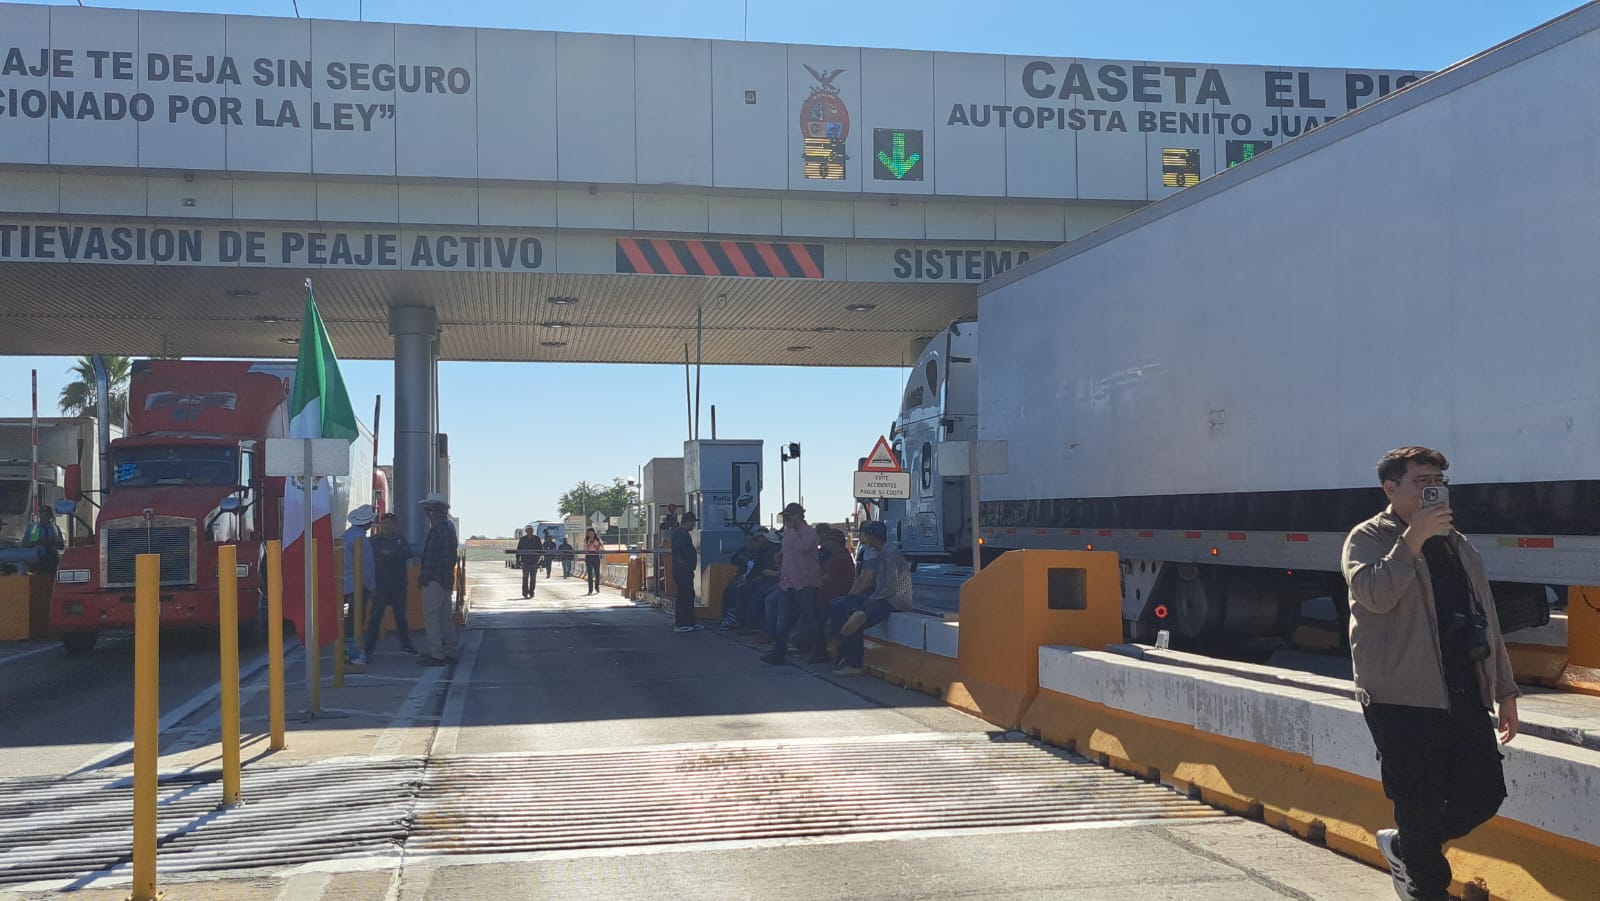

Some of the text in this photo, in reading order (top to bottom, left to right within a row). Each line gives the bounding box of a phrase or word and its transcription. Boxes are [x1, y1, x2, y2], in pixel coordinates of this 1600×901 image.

[2, 47, 471, 95] AJE TE DEJA SIN SEGURO
[1021, 60, 1231, 105] CASETA
[1264, 71, 1326, 108] EL
[168, 95, 243, 126] POR
[255, 98, 300, 128] LA
[947, 103, 1338, 137] AUTOPISTA BENITO JUA
[219, 231, 266, 263] DE
[282, 233, 397, 265] PEAJE
[411, 236, 543, 269] ACTIVO
